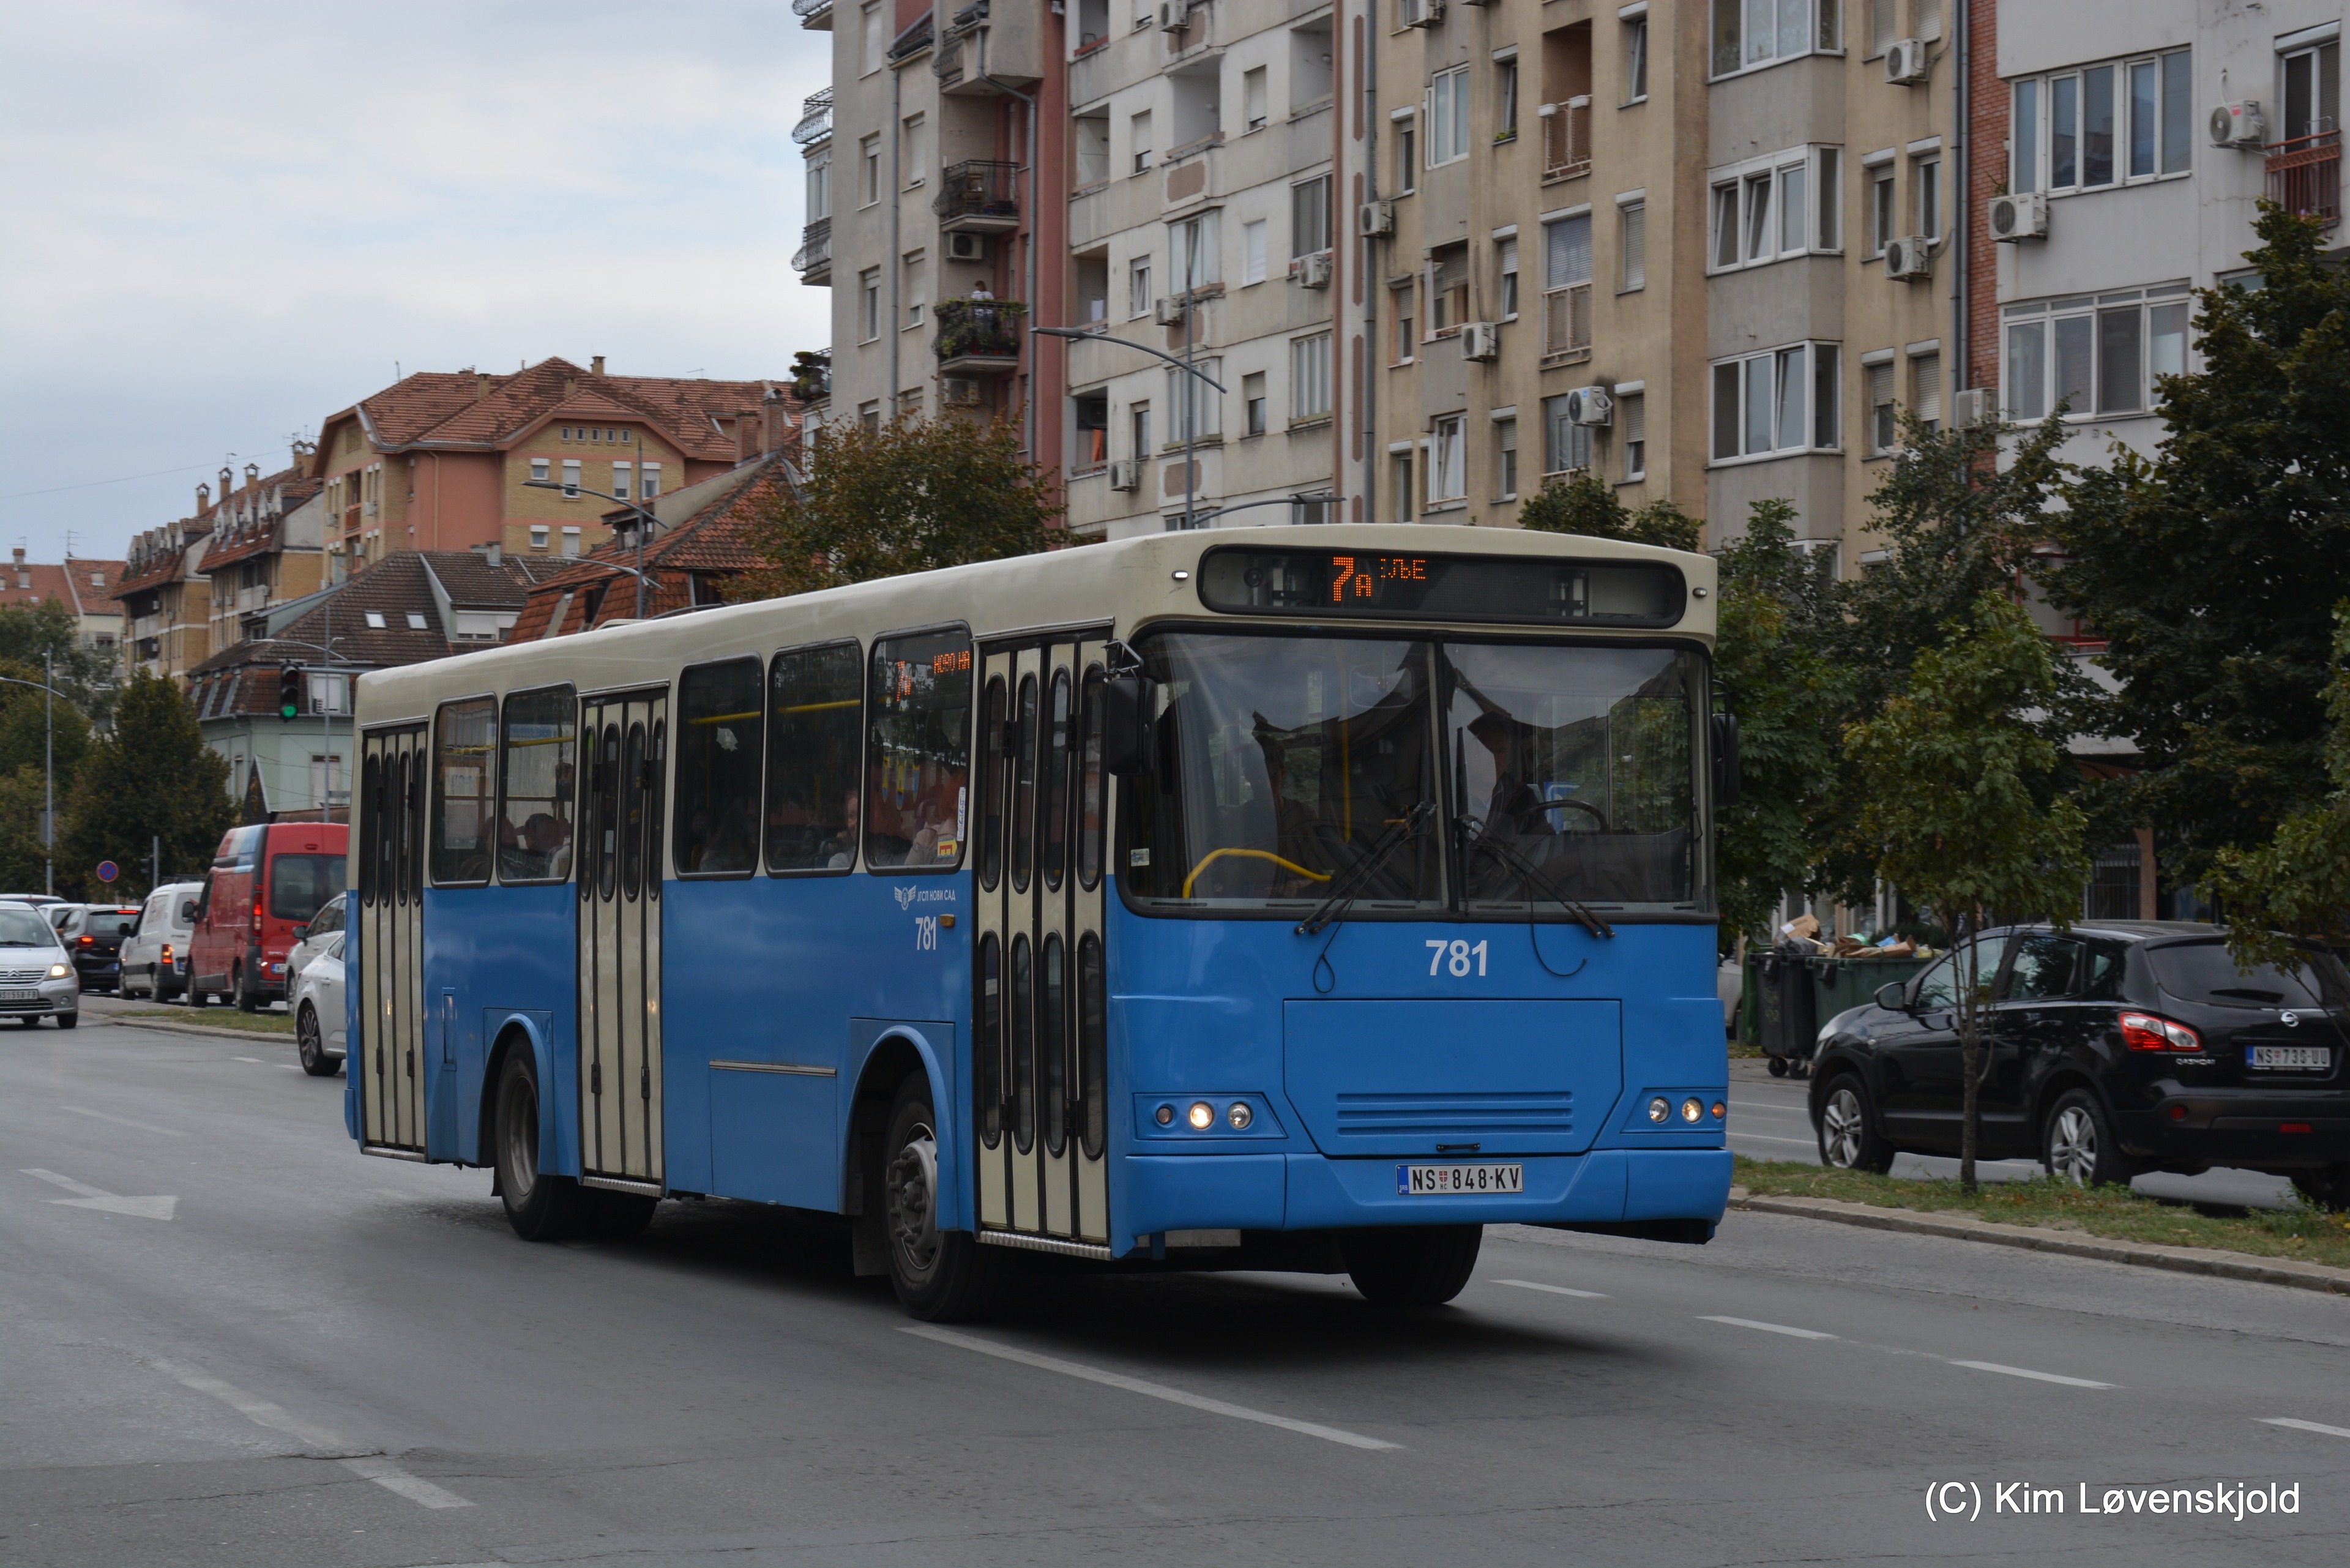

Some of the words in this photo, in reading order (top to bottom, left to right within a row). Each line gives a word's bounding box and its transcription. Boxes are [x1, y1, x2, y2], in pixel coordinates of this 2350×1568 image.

[930, 890, 944, 901] НОВИ
[944, 889, 956, 901] САД
[916, 916, 936, 950] 781
[1425, 940, 1488, 977] 781
[2256, 1048, 2272, 1064] NS
[1412, 1169, 1436, 1190] NS
